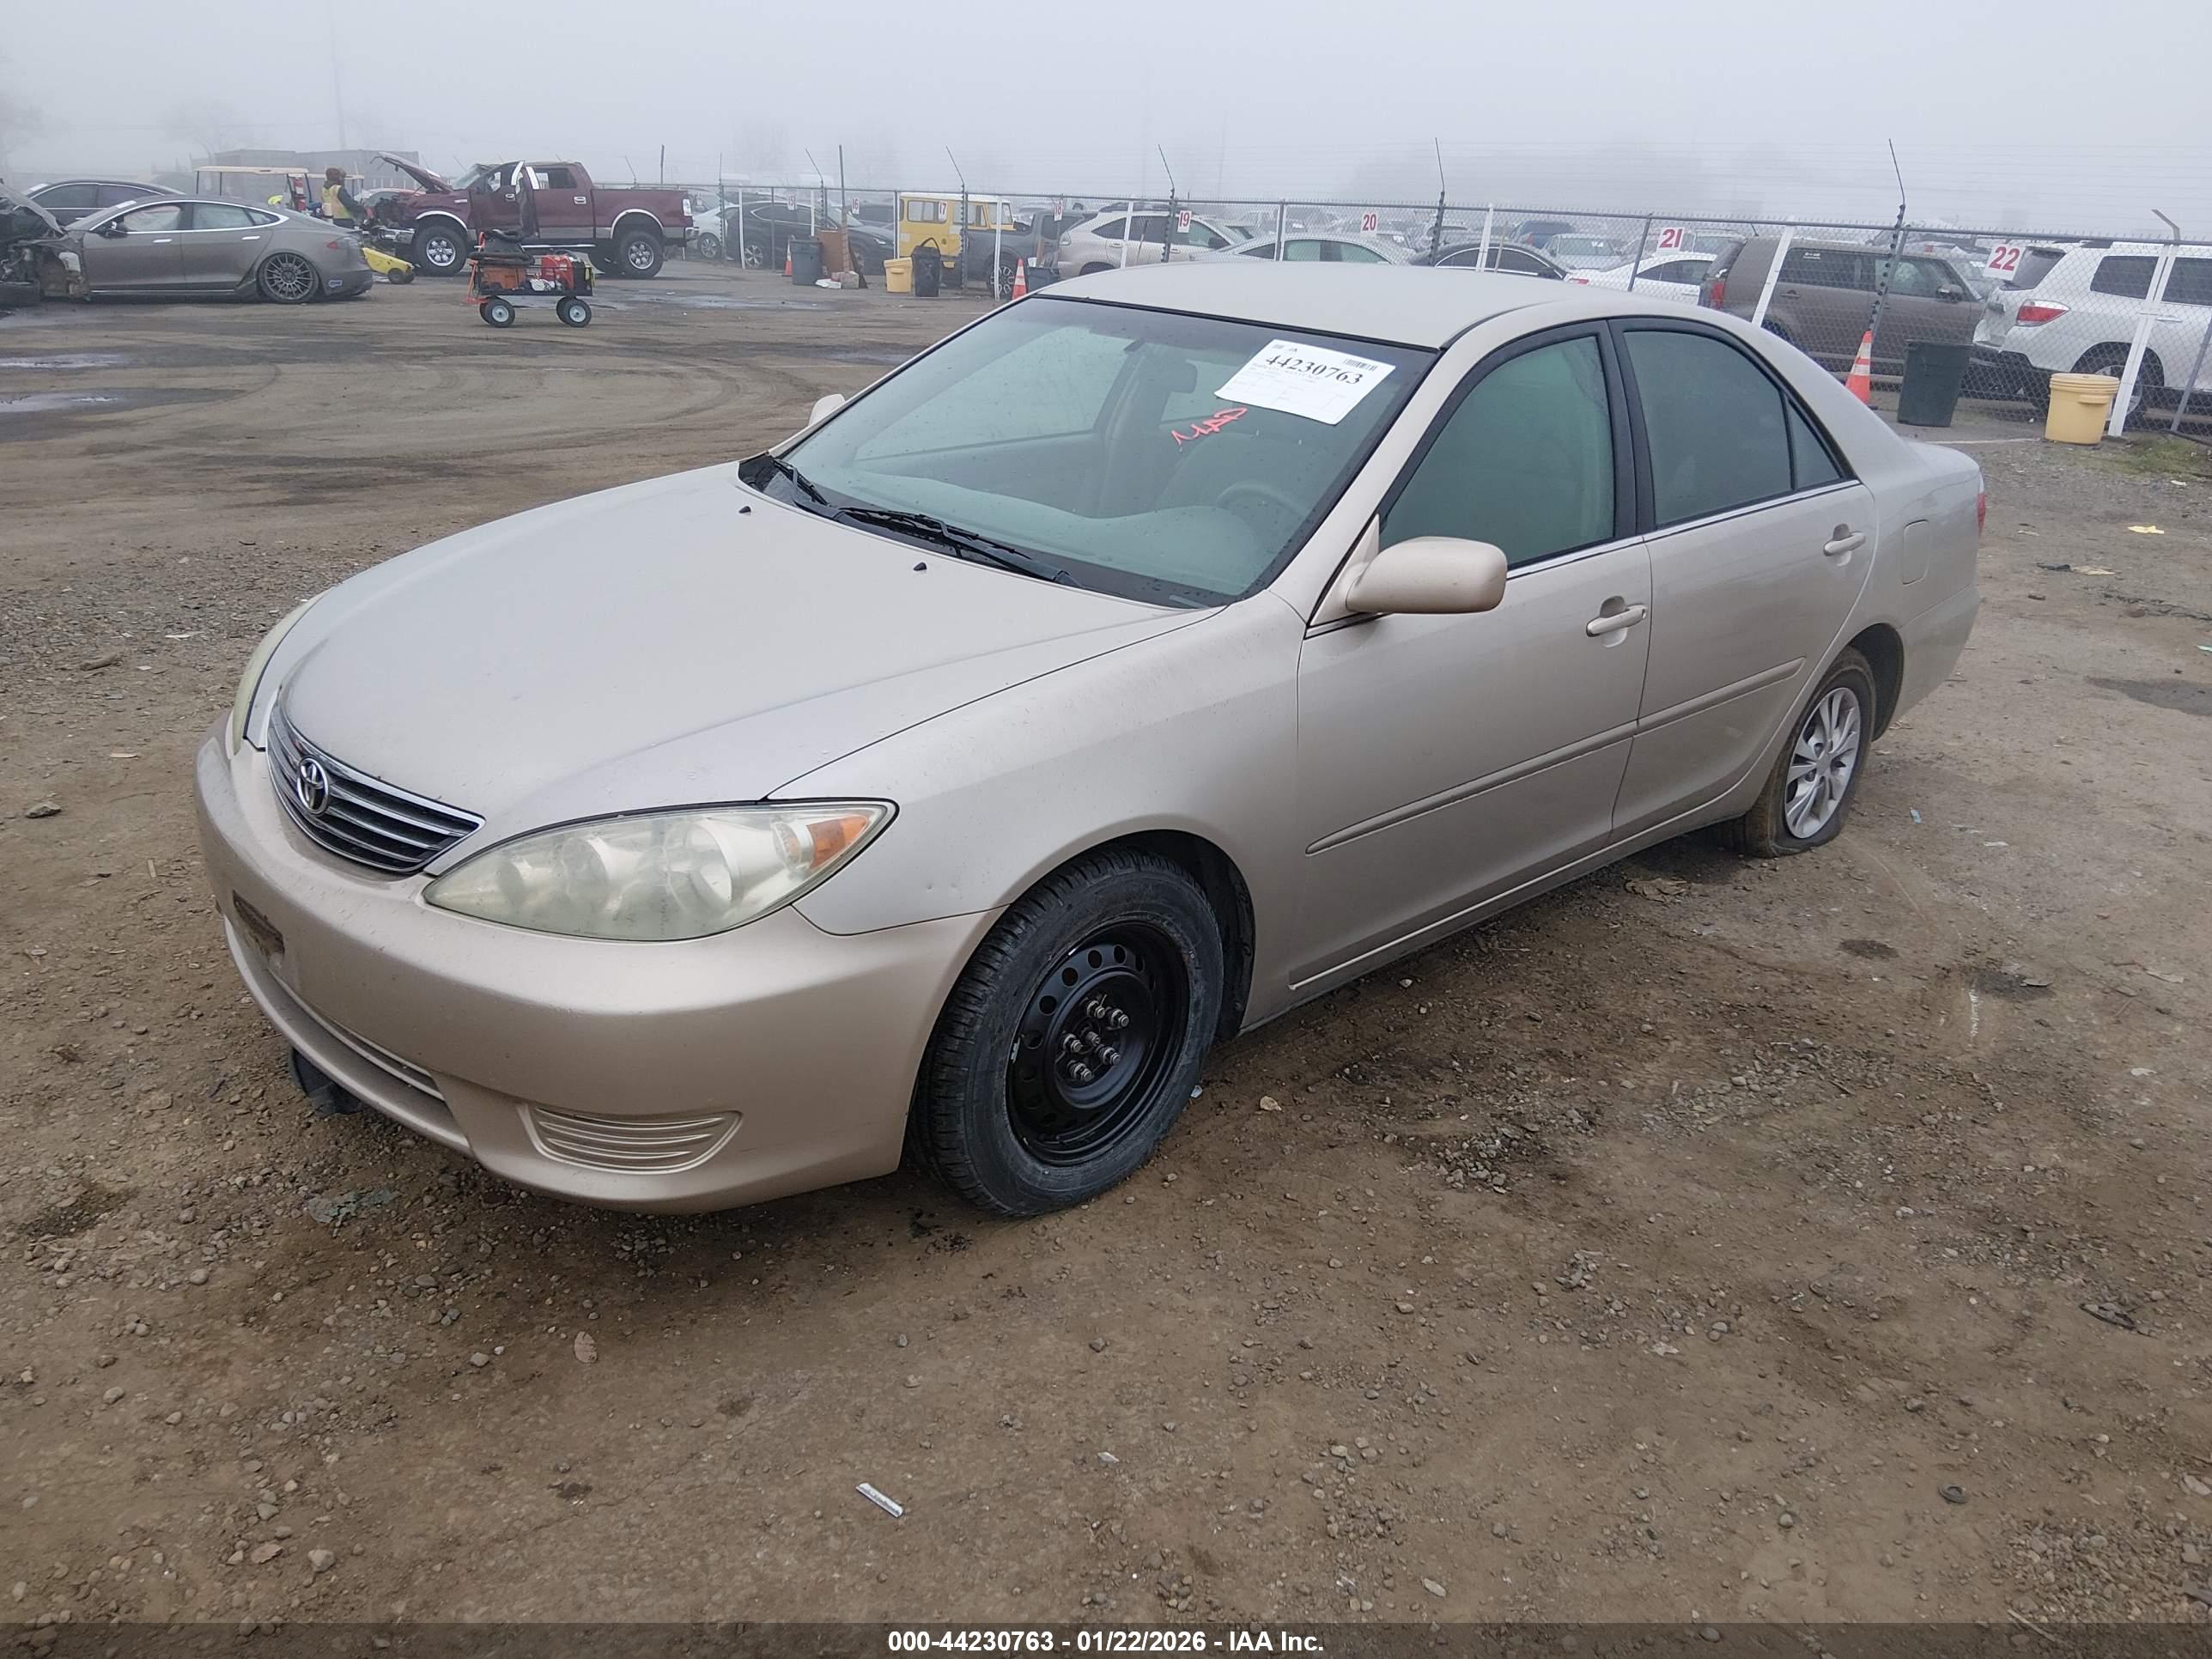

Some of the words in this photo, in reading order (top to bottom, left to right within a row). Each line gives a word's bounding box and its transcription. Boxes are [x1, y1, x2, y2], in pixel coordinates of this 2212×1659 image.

[852, 198, 859, 210] 16
[939, 202, 947, 215] 17
[1179, 211, 1190, 228] 19
[1362, 214, 1377, 231] 20
[1659, 228, 1683, 248] 21
[1988, 246, 2021, 271] 22
[1265, 355, 1364, 386] 44230763
